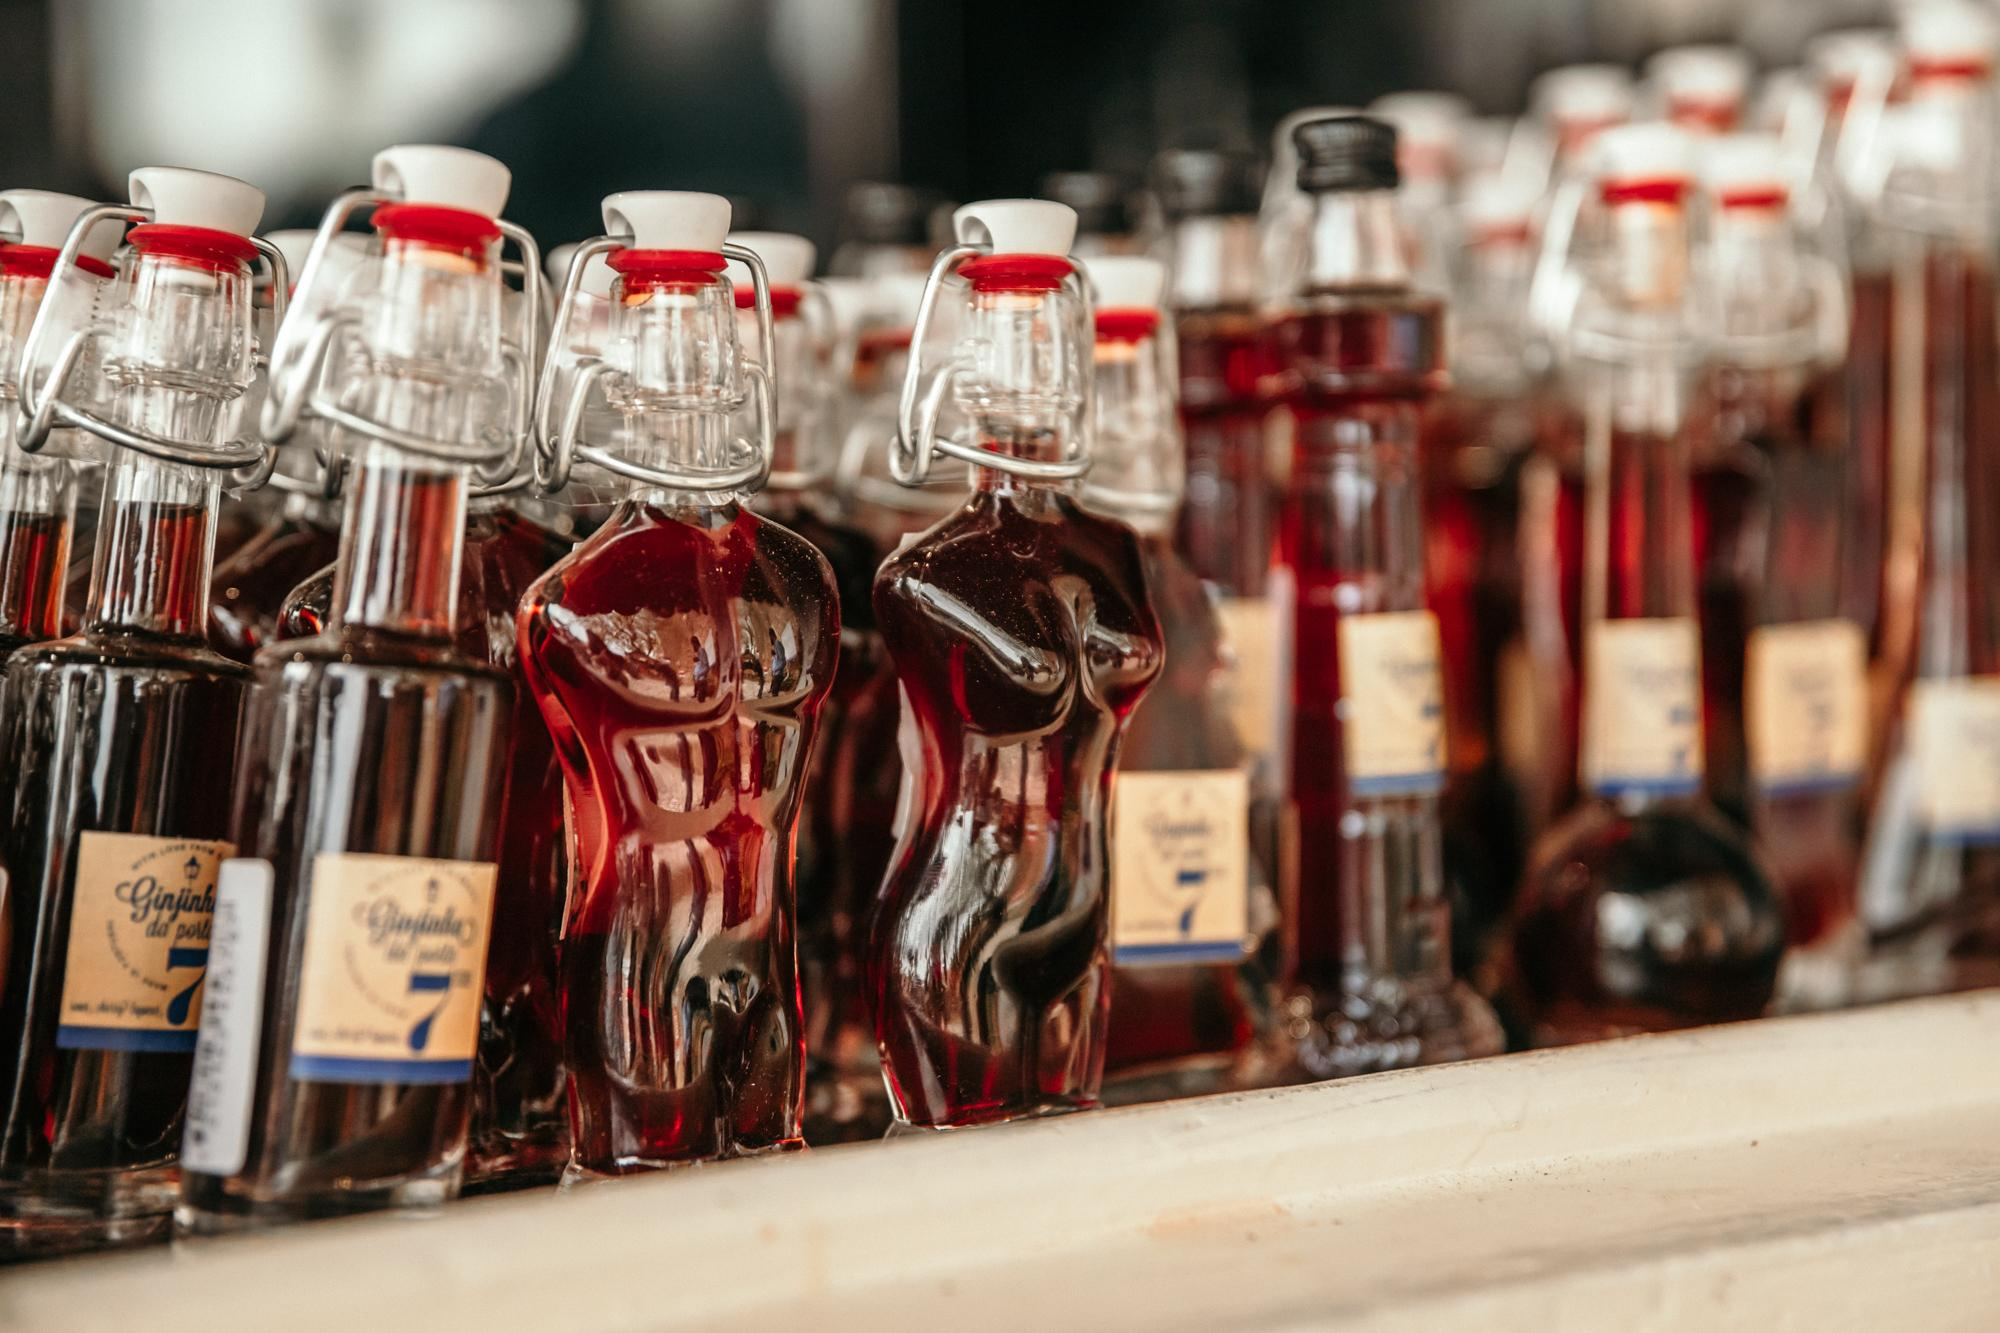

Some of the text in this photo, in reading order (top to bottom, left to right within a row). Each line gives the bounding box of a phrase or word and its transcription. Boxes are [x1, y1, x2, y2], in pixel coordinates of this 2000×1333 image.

[114, 875, 215, 923] Ginjinh
[165, 946, 210, 1026] 7
[407, 972, 452, 1053] 7
